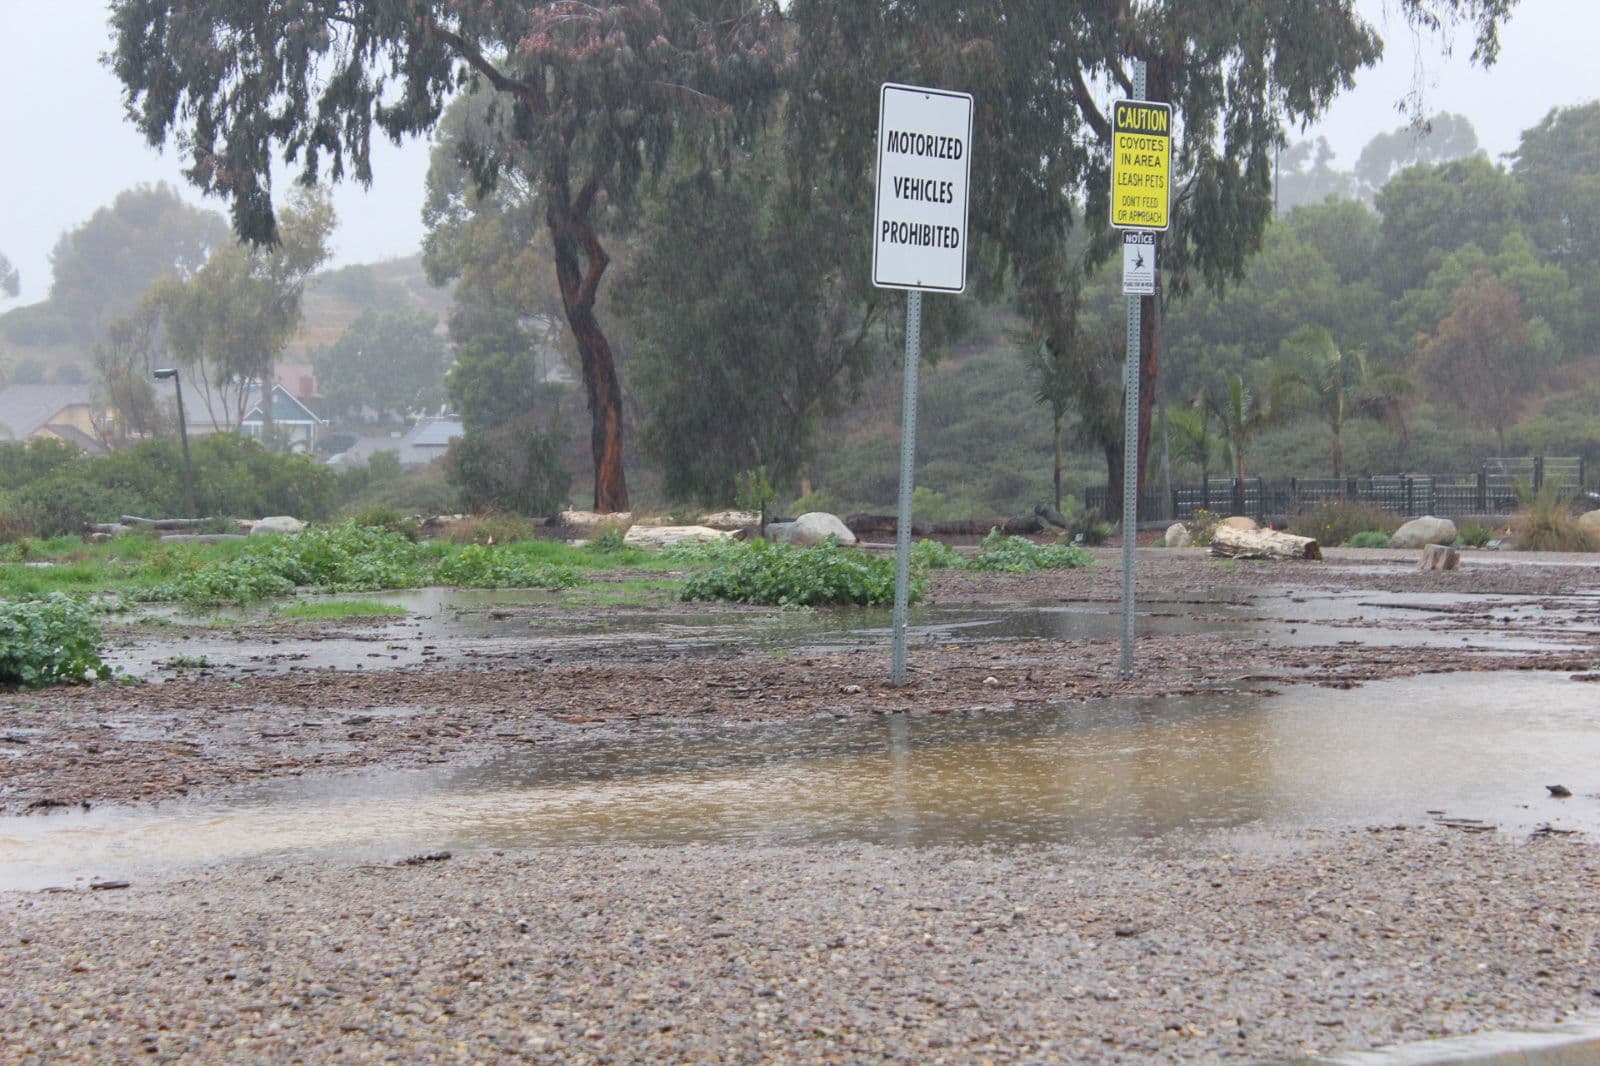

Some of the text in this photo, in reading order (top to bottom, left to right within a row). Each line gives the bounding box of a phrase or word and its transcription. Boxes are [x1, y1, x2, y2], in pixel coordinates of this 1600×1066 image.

[1117, 106, 1167, 131] CAUTION
[887, 130, 963, 160] MOTORIZED
[1119, 136, 1164, 152] COYOTES
[1121, 153, 1161, 168] IN AREA
[1118, 172, 1164, 188] LEASH PETS
[893, 176, 953, 204] VEHICLES
[1142, 196, 1158, 208] FEED
[1118, 210, 1162, 223] OR APPROACH
[881, 220, 959, 249] PROHIBITED
